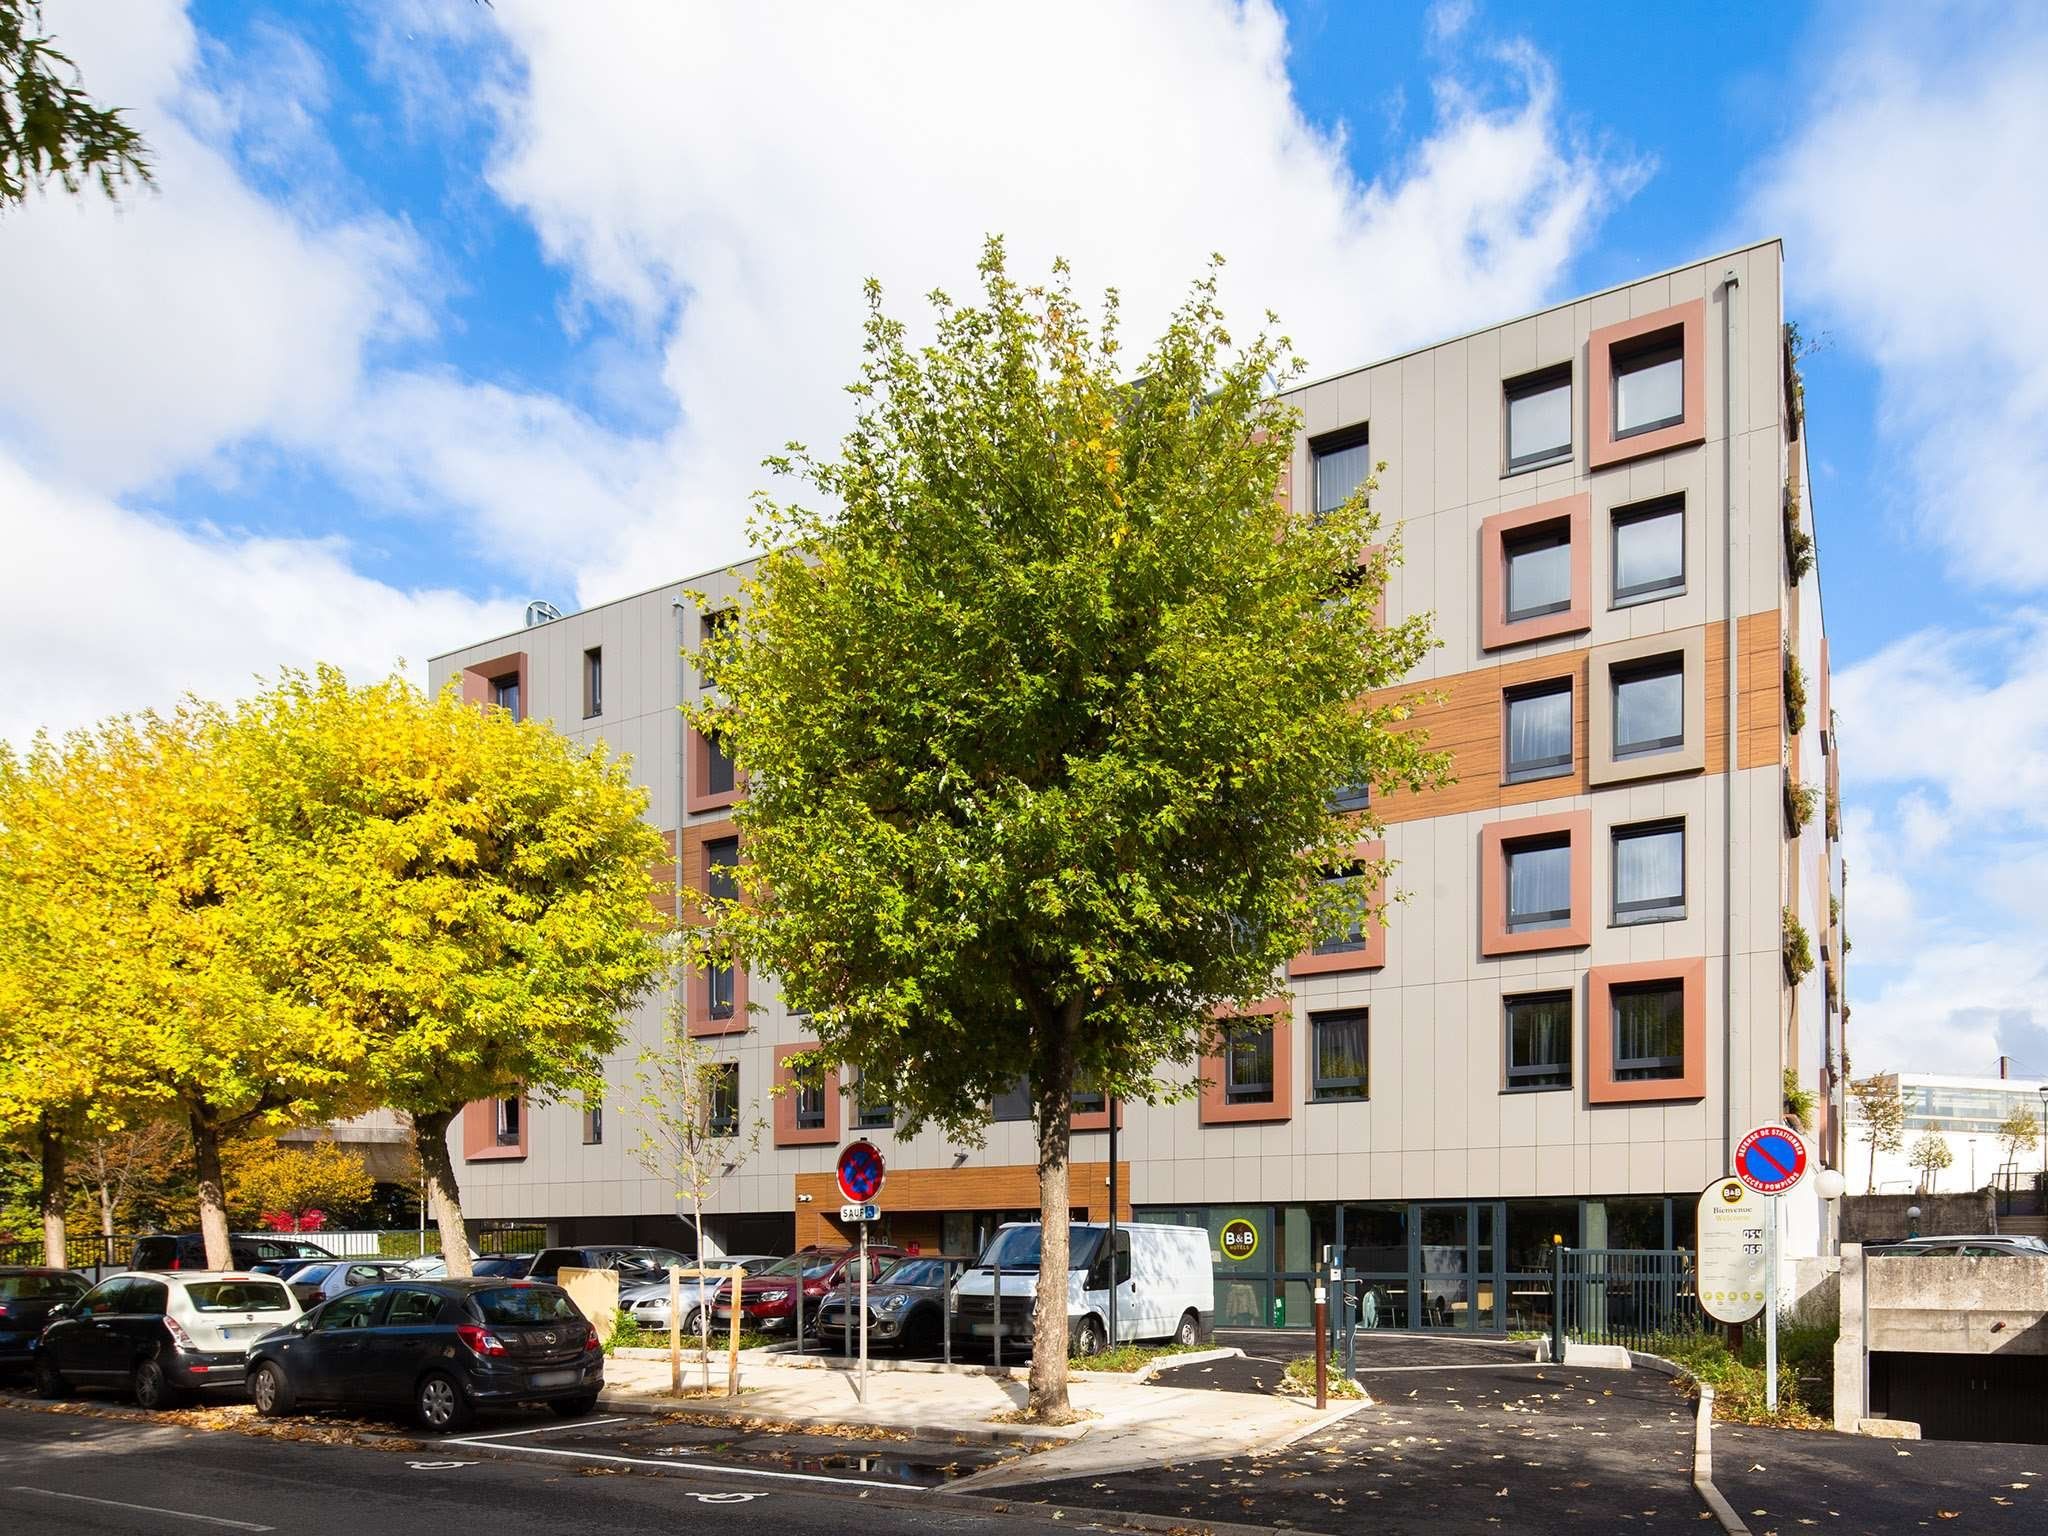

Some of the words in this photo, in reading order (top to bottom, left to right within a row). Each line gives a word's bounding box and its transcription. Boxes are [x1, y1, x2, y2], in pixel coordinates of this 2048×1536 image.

[1760, 1129, 1770, 1137] DE
[1771, 1129, 1804, 1156] STATIONNER
[1764, 1171, 1800, 1190] POMPIERS
[843, 1208, 864, 1218] SAUF
[1225, 1231, 1254, 1245] B&B
